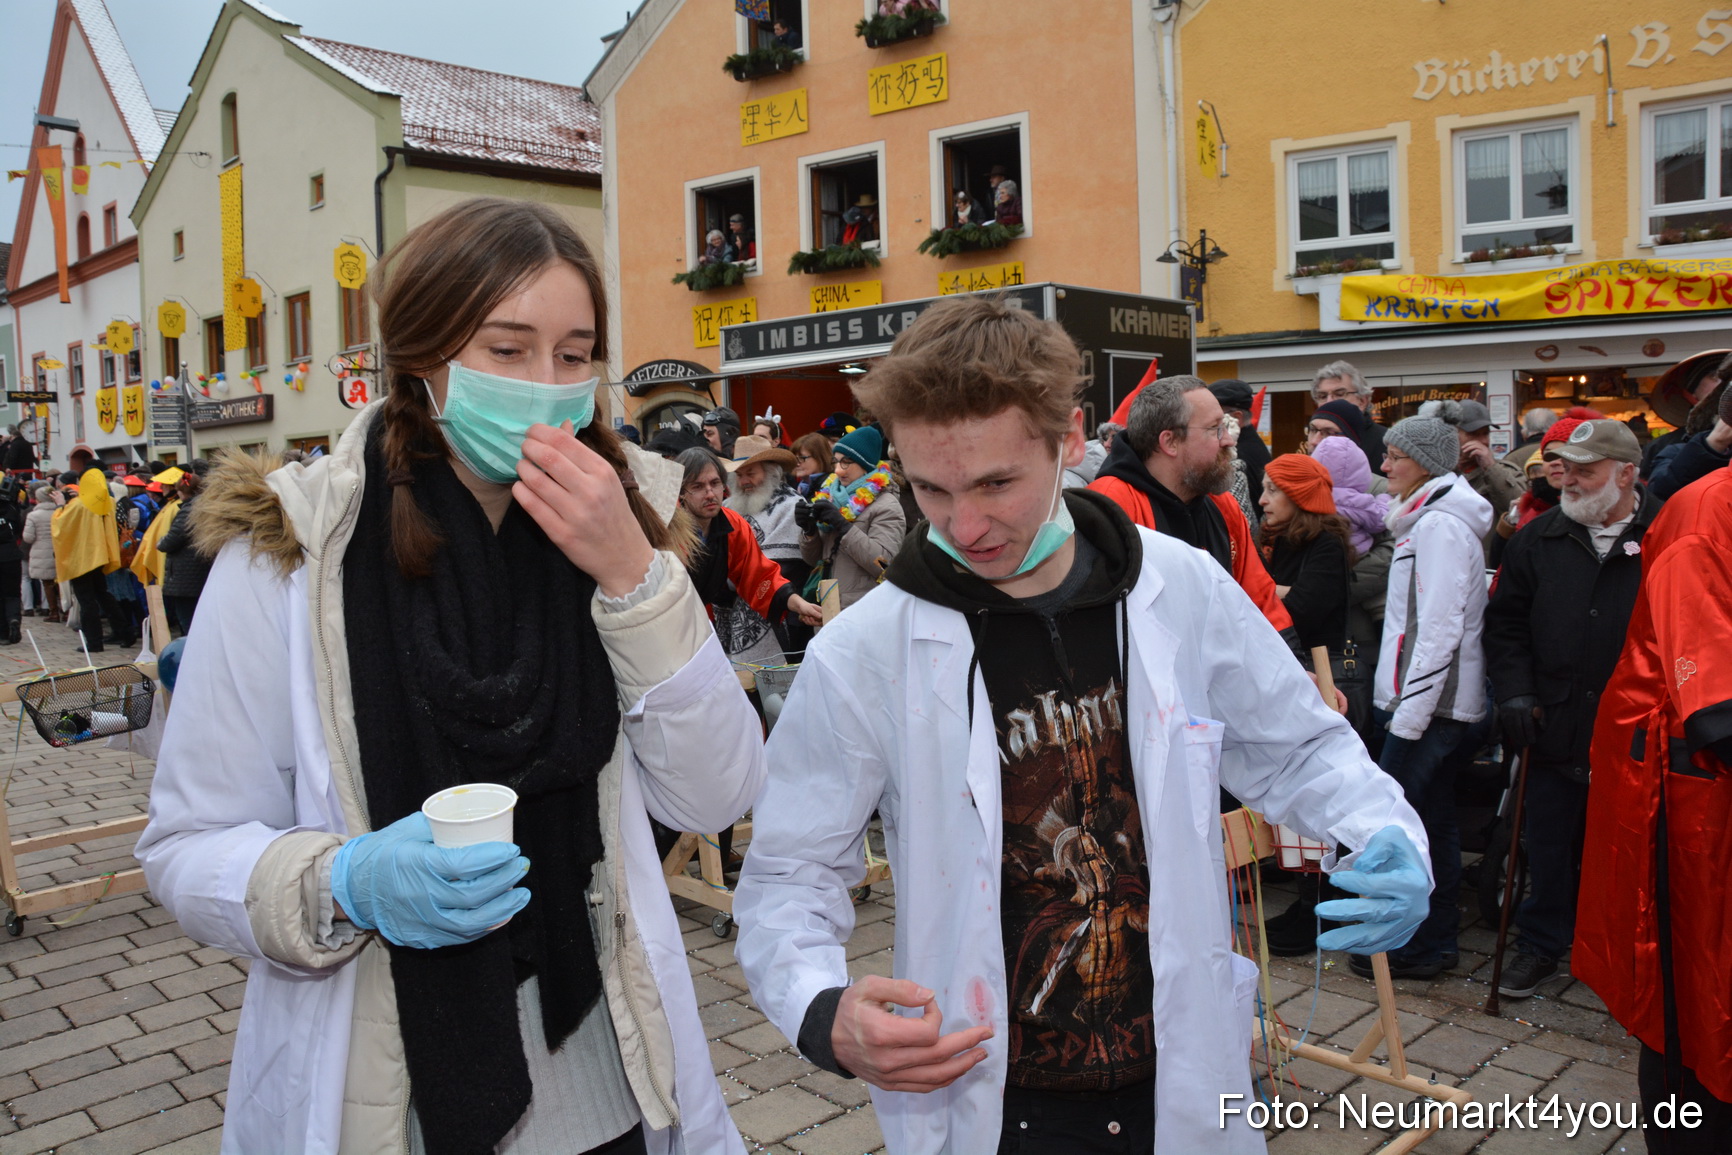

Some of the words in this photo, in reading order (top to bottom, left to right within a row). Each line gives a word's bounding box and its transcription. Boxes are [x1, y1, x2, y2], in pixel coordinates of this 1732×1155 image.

[1412, 33, 1605, 101] Bäckerei
[1626, 20, 1676, 68] B.
[870, 55, 945, 105] 你好吗
[814, 284, 850, 303] CHINA
[1397, 277, 1467, 297] CHINA
[1544, 271, 1732, 315] SPITZER
[1364, 295, 1501, 319] KRAPFEN
[758, 317, 863, 351] IMBISS
[1110, 305, 1191, 339] KRÄMER
[222, 400, 257, 419] APOTHEKE
[1403, 389, 1426, 404] und
[1428, 388, 1470, 401] Brezen
